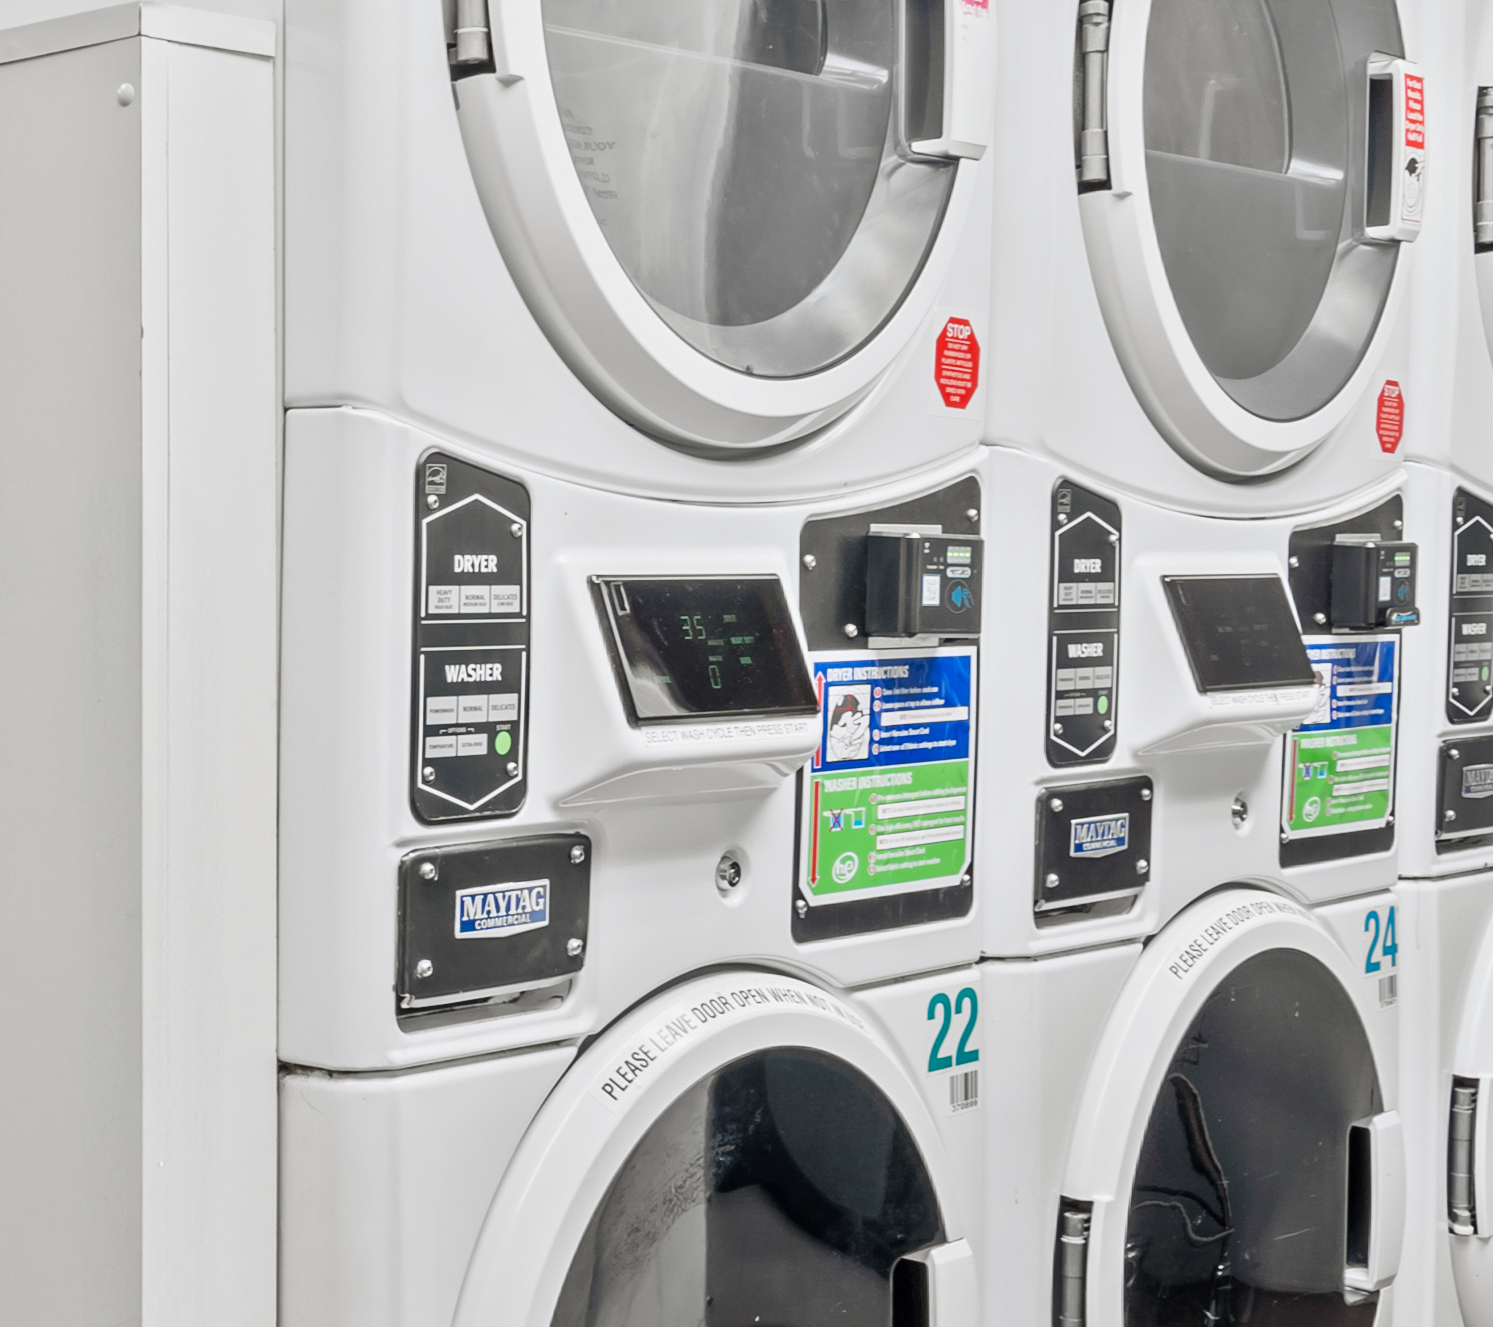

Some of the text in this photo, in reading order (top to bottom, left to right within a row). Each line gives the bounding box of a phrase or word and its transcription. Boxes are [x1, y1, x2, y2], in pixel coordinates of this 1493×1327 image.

[946, 323, 972, 340] STOP
[454, 554, 498, 573] DRYER
[1073, 559, 1102, 573] DRYER
[680, 615, 706, 640] 35
[1067, 643, 1103, 658] WASHER
[445, 663, 502, 683] WASHER
[827, 666, 909, 682] DRYER INSTRUCTIONS
[645, 722, 808, 743] SELECT WASH CYCLE THEN PRESS START
[824, 772, 913, 792] WASHER INSTRUCTIONS
[1075, 819, 1126, 844] MAYTAG
[462, 887, 545, 921] MAYTAG
[475, 914, 530, 929] COMMERCIAL
[1169, 901, 1275, 980] PLEASE LEAVE DOOR OPEN
[1364, 906, 1398, 973] 24
[927, 987, 980, 1073] 22
[601, 1046, 656, 1101] PLEASE
[650, 1013, 696, 1053] LEAVE
[691, 995, 734, 1024] DOOR
[731, 988, 769, 1009] OPEN
[766, 987, 808, 1005] WHEN
